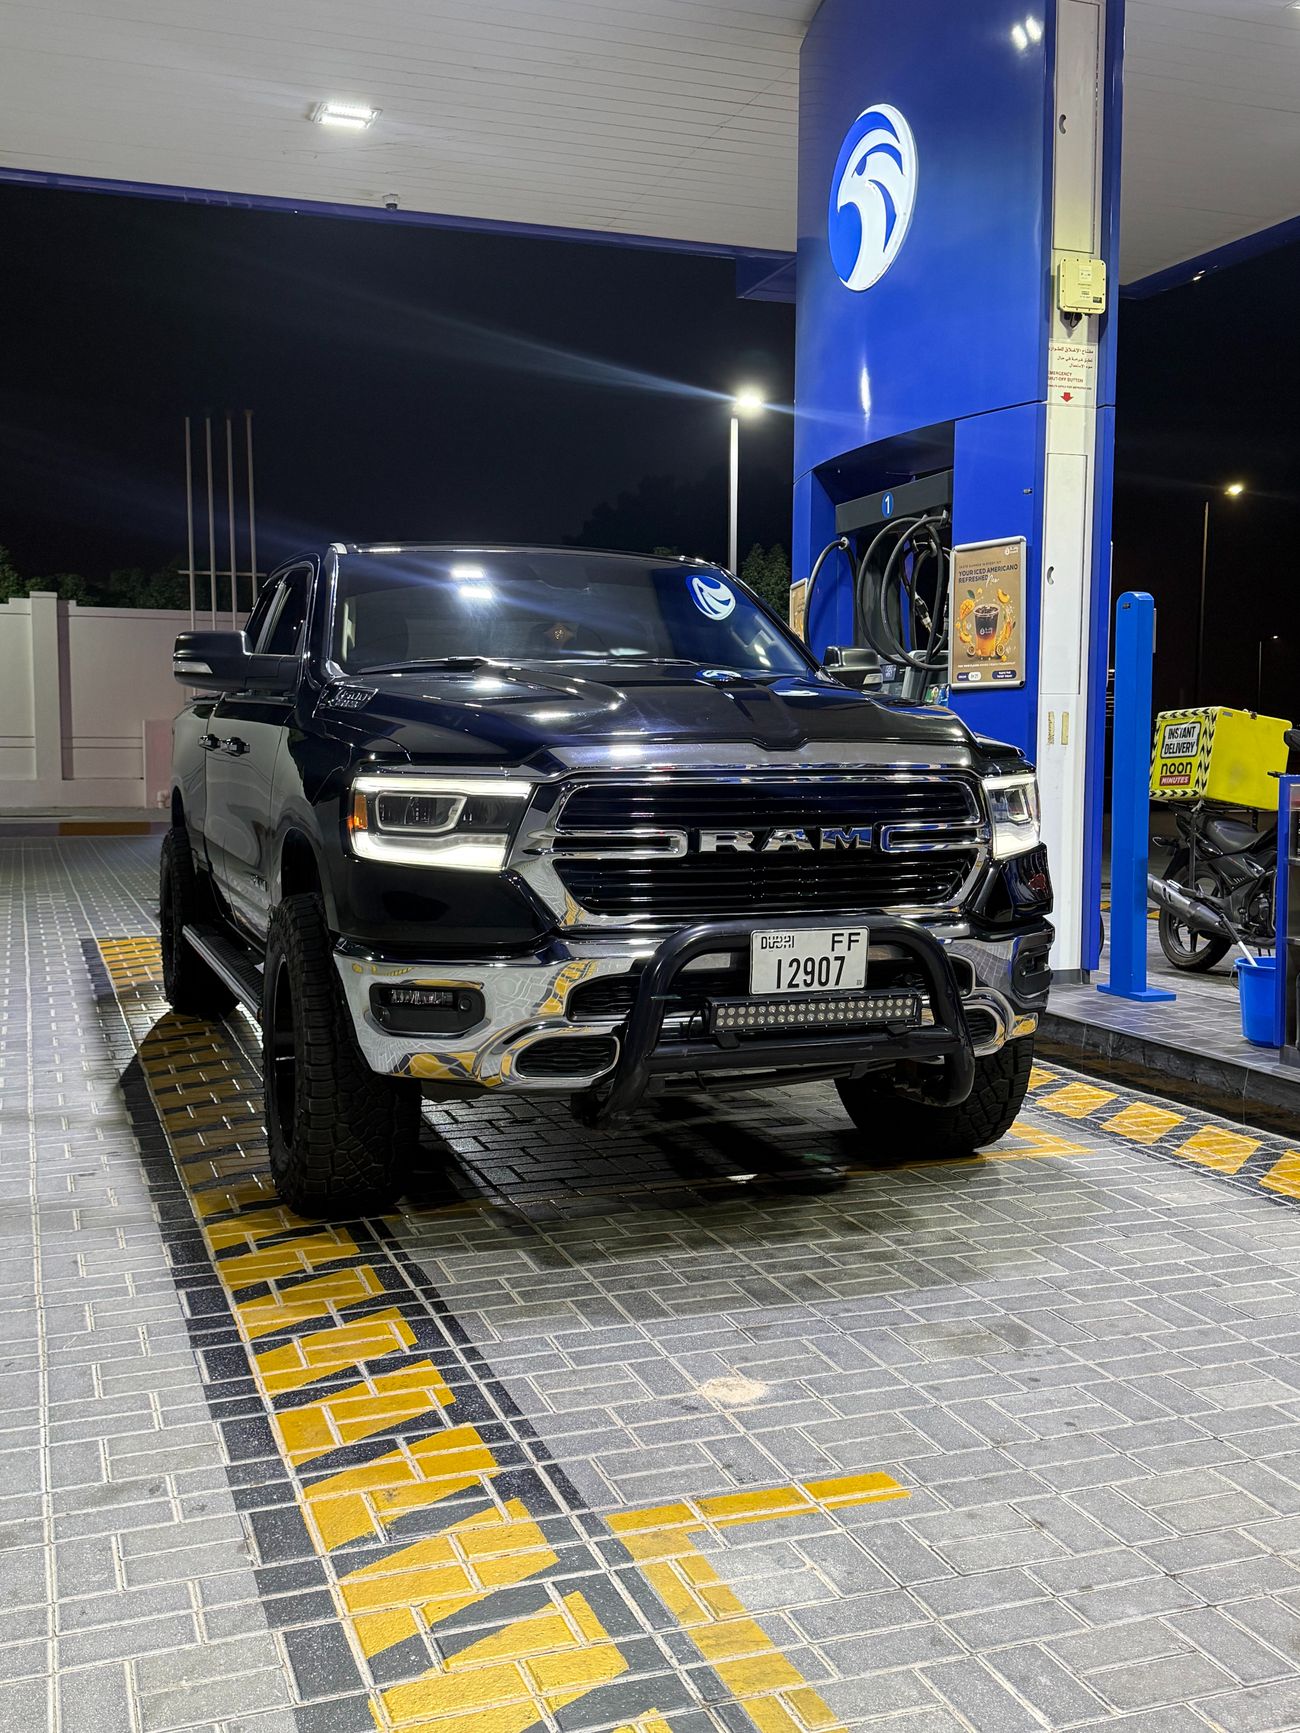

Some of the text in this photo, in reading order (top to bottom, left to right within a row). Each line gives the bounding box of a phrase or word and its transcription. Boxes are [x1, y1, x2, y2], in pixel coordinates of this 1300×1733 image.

[885, 496, 890, 514] 1
[959, 569, 974, 577] YOUR
[986, 564, 1019, 574] AMERICANO
[959, 575, 988, 584] REFRESHED
[1167, 726, 1196, 740] INSTANT
[1164, 741, 1196, 755] DELIVERY
[1161, 762, 1193, 775] noon
[1161, 776, 1189, 785] MINUTES
[699, 827, 872, 852] RAM
[761, 932, 861, 952] DUBAI FF
[776, 956, 846, 989] 12907
